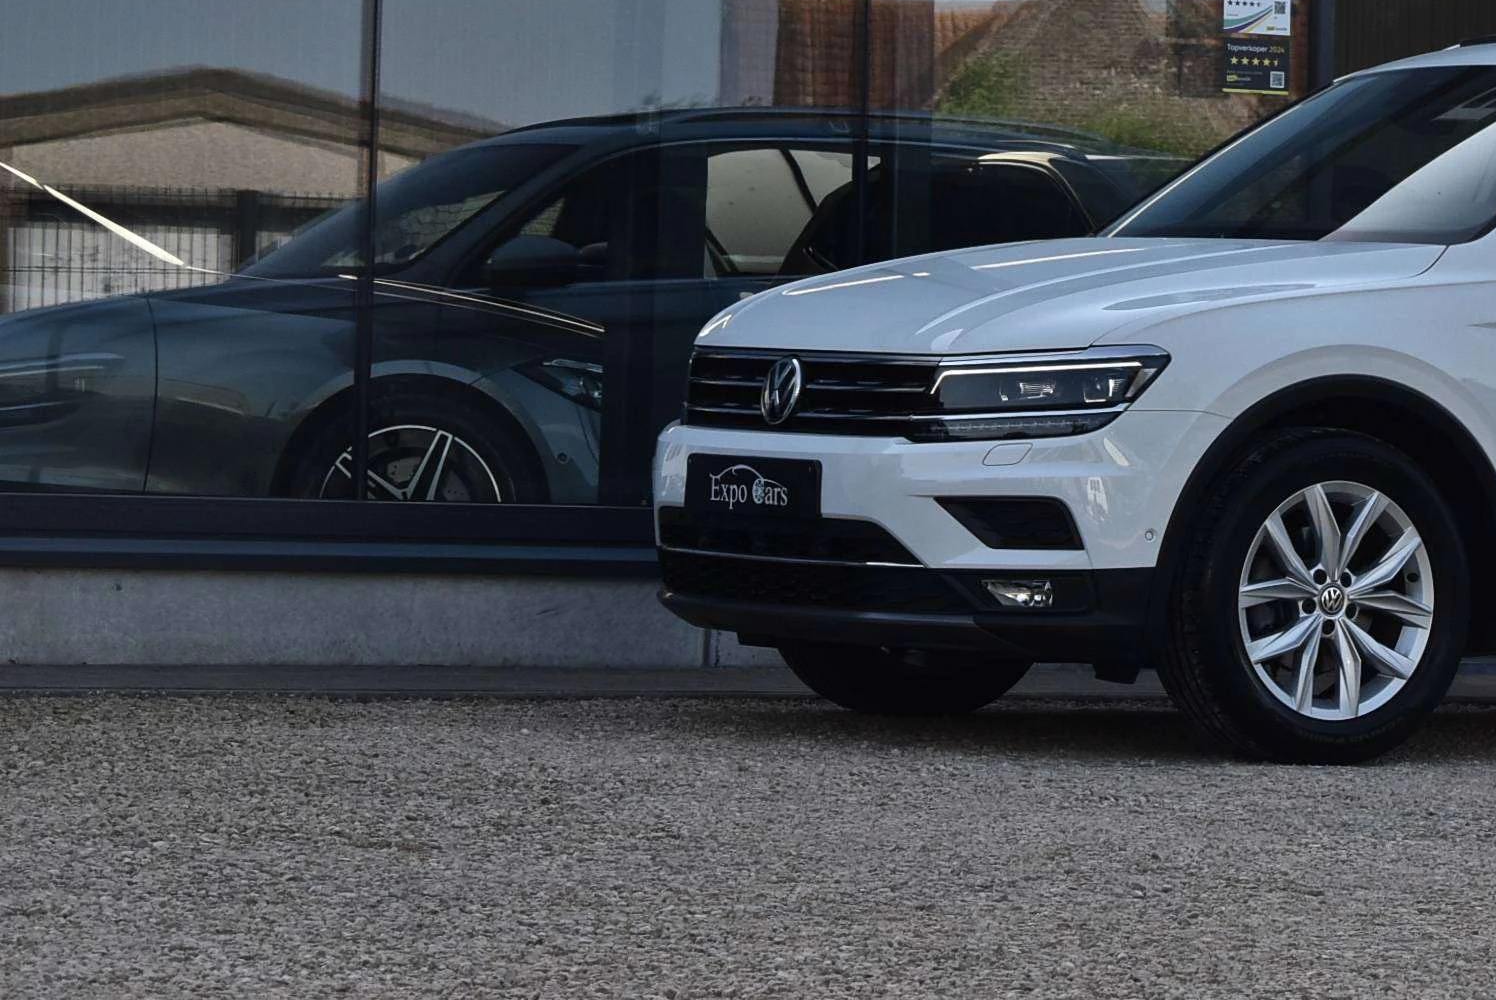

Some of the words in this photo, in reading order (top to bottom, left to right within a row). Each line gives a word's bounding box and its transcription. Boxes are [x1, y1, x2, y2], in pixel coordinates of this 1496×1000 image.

[1227, 43, 1267, 53] Topverkoper
[710, 474, 748, 510] Expo
[752, 478, 788, 506] Cars
